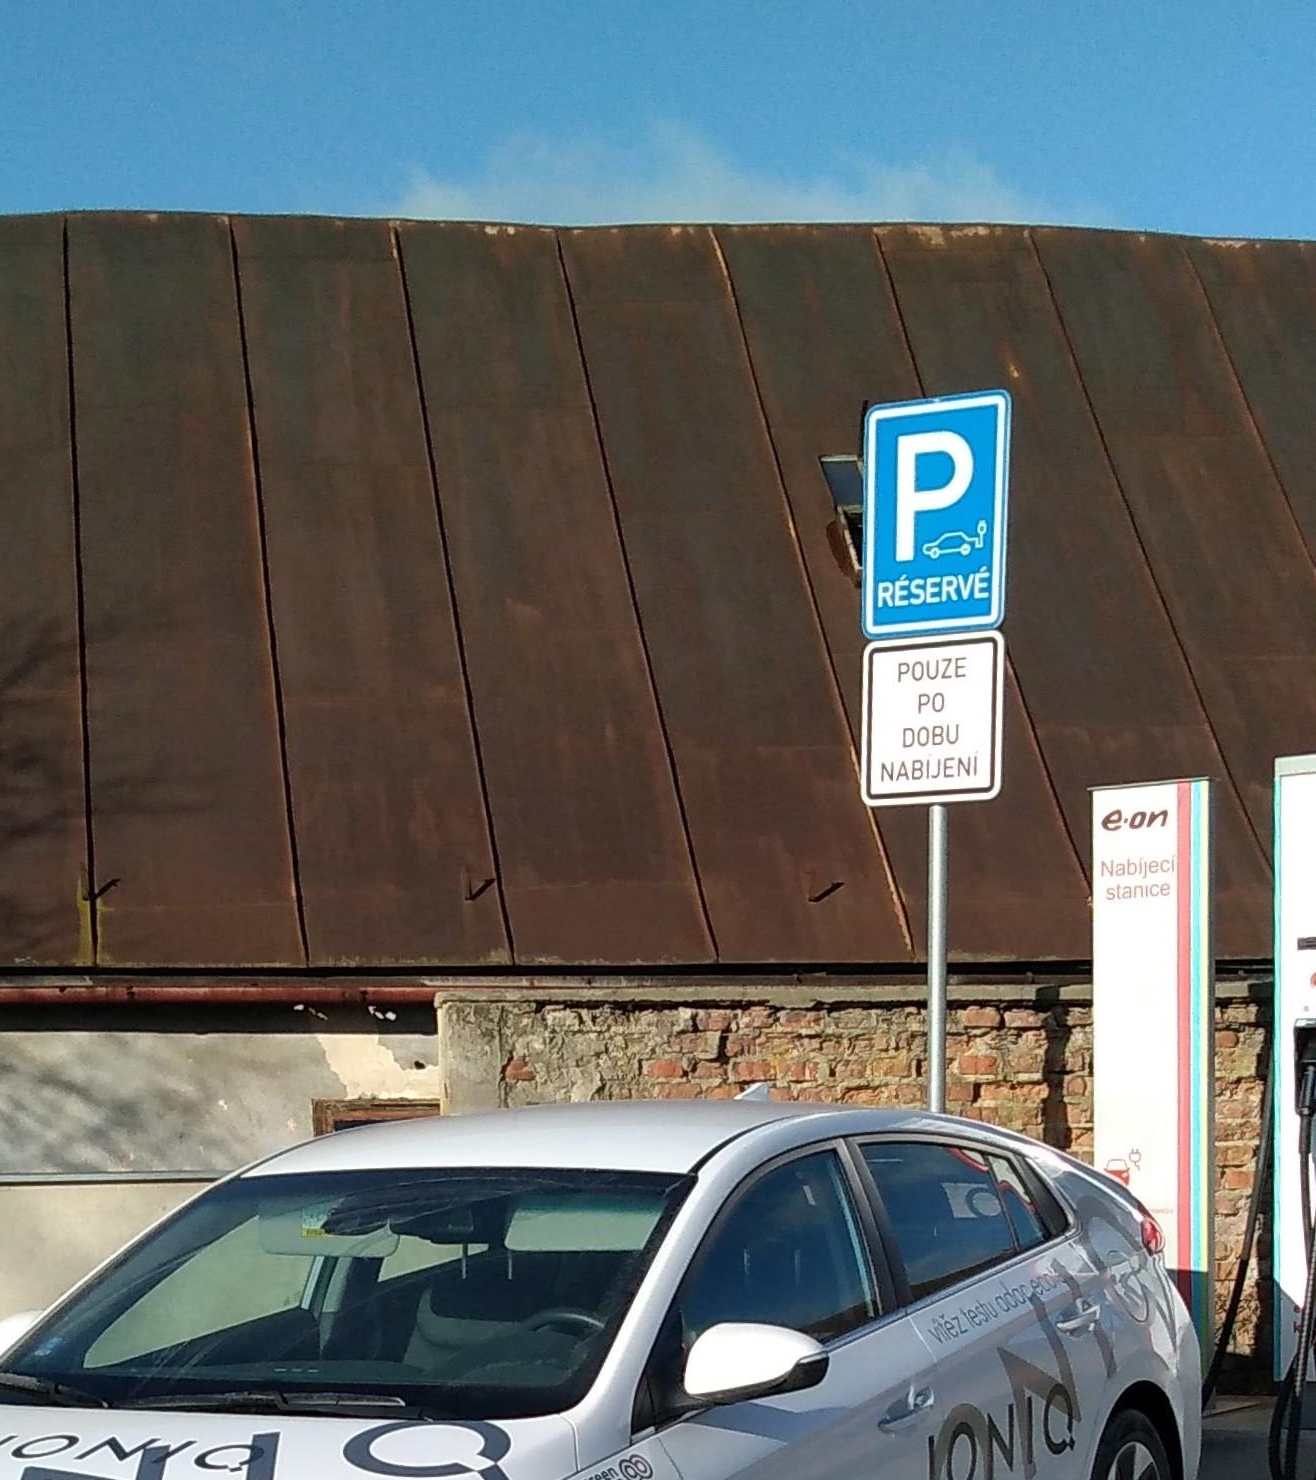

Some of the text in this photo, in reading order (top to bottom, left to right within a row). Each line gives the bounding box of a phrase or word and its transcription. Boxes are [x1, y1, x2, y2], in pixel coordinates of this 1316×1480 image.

[895, 430, 974, 562] P
[877, 566, 990, 608] RÉSERVÉ
[897, 656, 967, 683] POUZE
[917, 692, 945, 714] PO
[902, 724, 960, 749] DOBU
[880, 751, 979, 782] NABÍJENÍ
[1106, 883, 1171, 900] stanice
